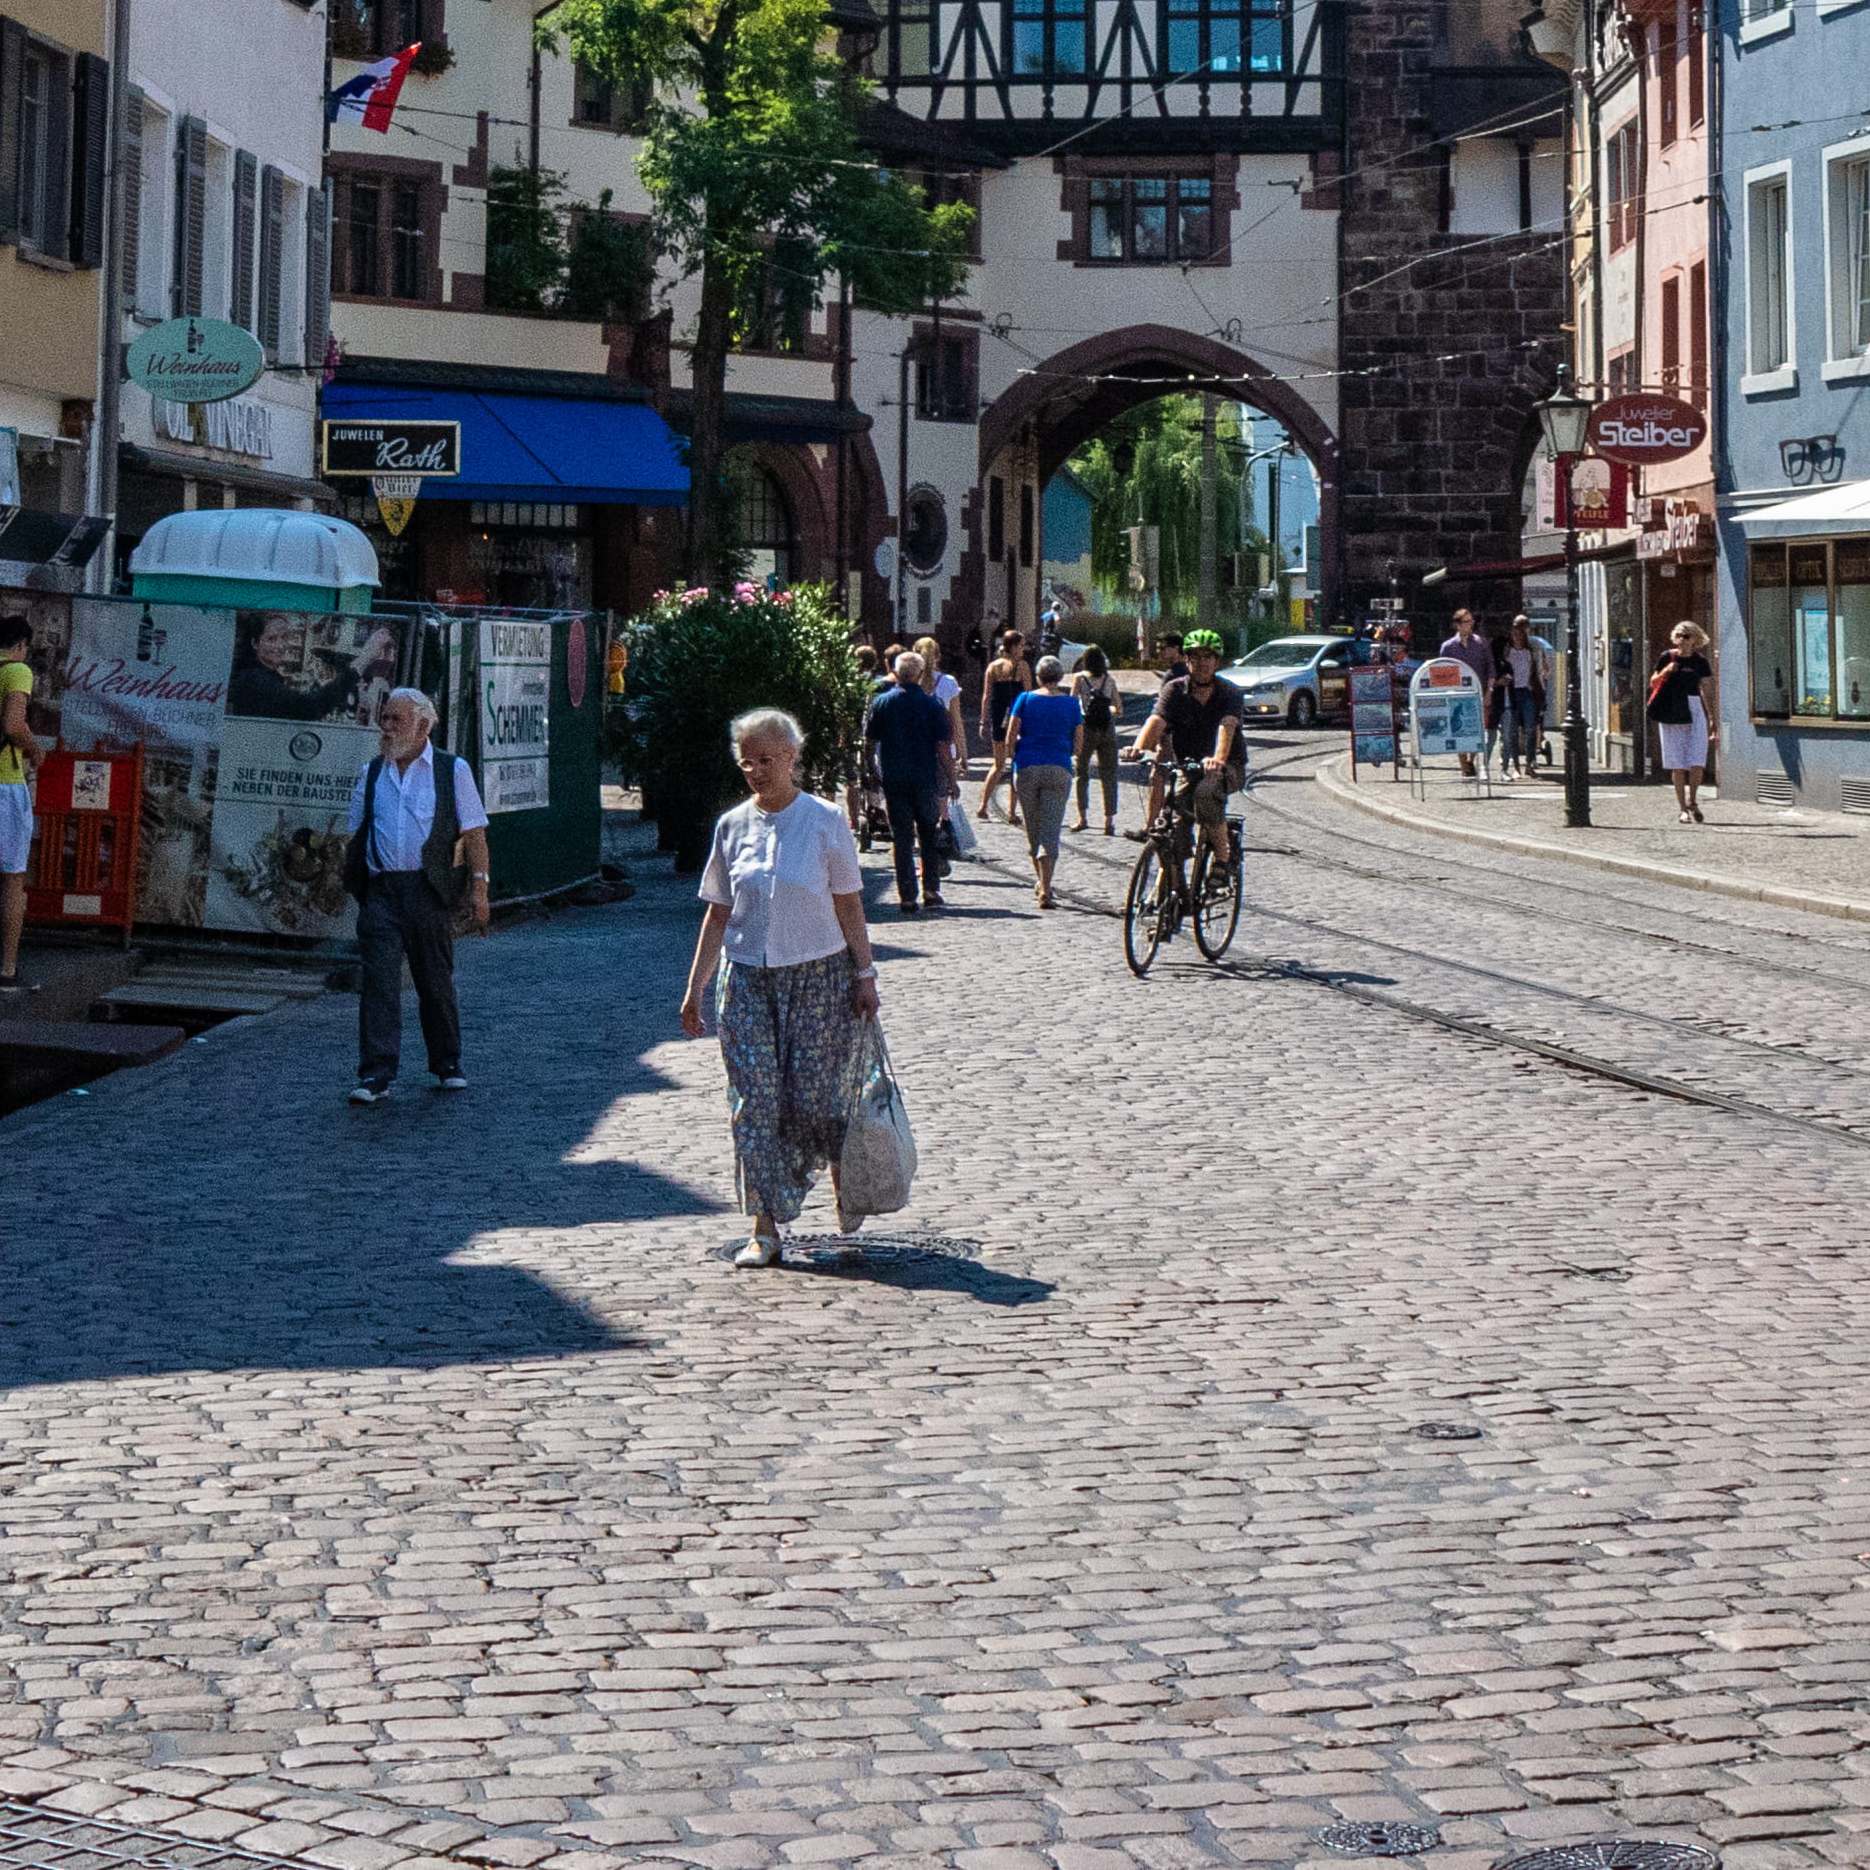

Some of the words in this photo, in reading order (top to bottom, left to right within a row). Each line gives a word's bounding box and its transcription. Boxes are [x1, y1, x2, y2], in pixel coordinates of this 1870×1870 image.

[146, 352, 244, 376] Weinhaus
[1616, 404, 1677, 422] Juwelier
[332, 429, 385, 441] JUWELEN
[1597, 420, 1701, 447] Steiber
[376, 437, 447, 470] Rath
[66, 656, 228, 704] Weinhaus
[237, 767, 257, 781] SIE
[260, 769, 304, 785] FINDEN
[307, 773, 332, 787] UNS
[232, 781, 274, 797] NEBEN
[276, 785, 300, 800] DER
